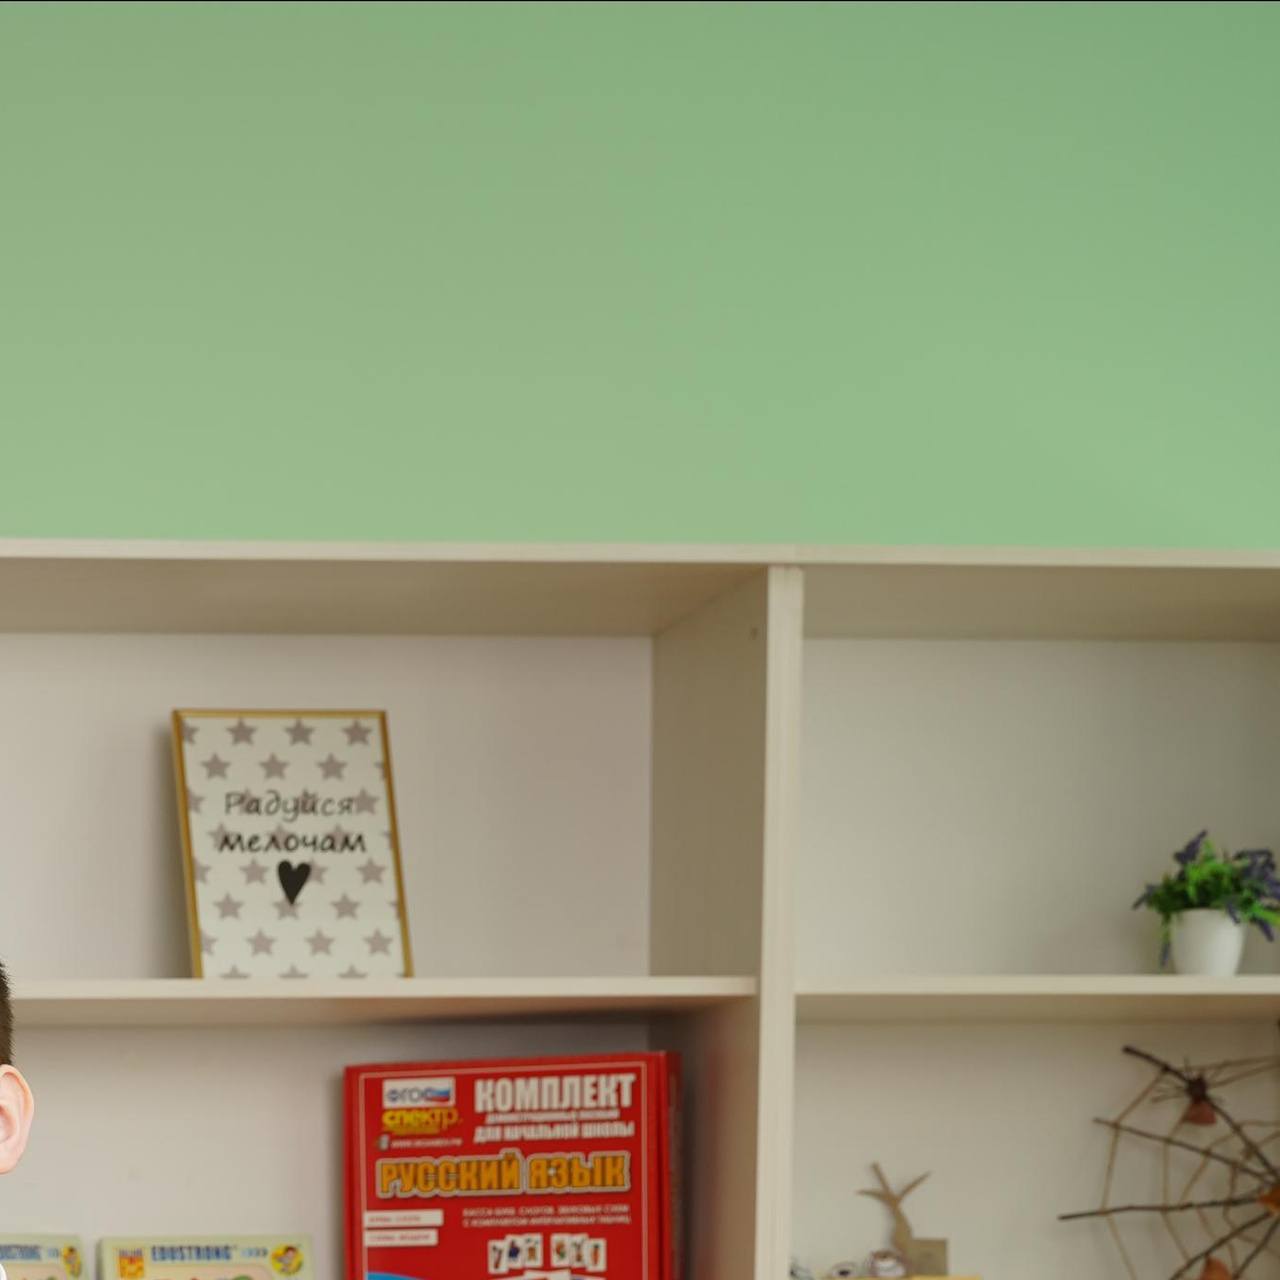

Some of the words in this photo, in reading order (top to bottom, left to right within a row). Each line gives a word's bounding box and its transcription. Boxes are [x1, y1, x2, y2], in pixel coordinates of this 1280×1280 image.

[225, 789, 355, 822] Радуйся
[219, 833, 367, 852] мелочам
[475, 1073, 636, 1113] КОМПЛЕКТ
[379, 1150, 522, 1196] РУССКИЙ
[527, 1153, 629, 1191] ЯЗЫК
